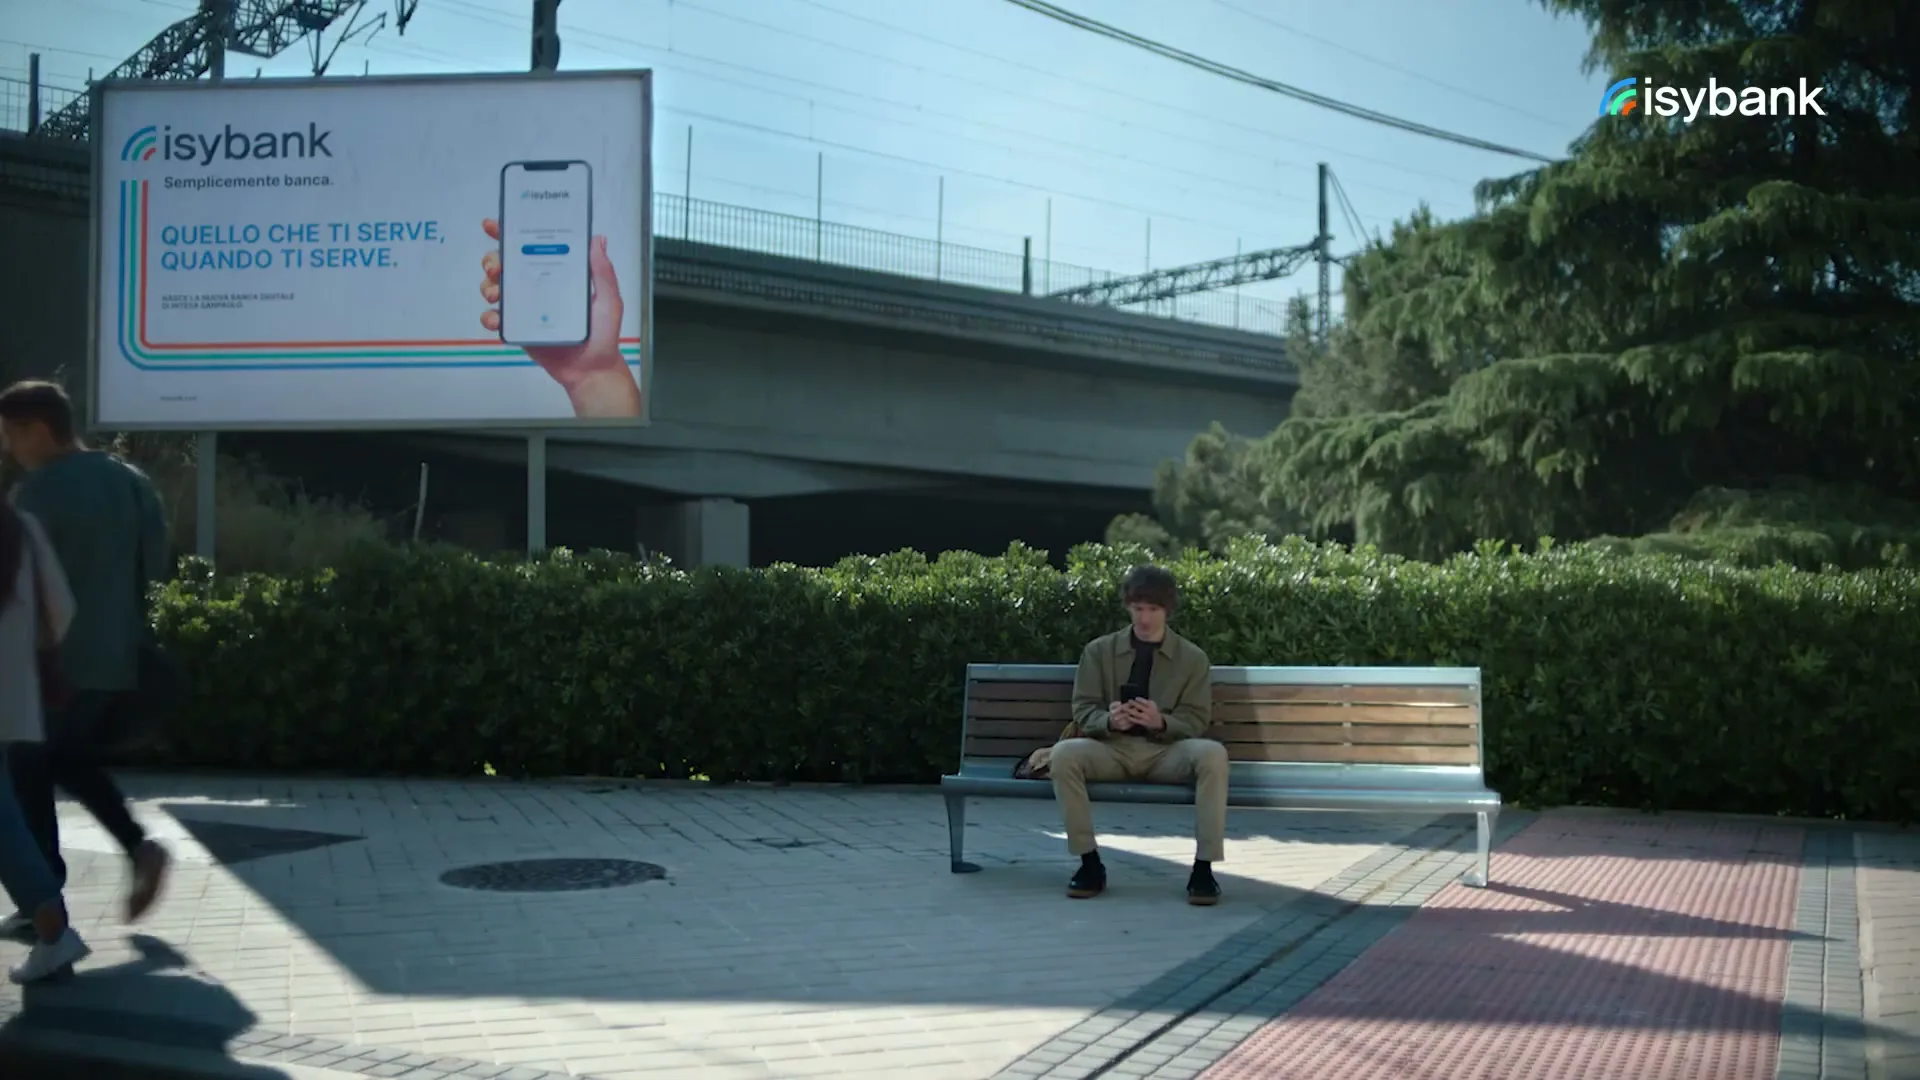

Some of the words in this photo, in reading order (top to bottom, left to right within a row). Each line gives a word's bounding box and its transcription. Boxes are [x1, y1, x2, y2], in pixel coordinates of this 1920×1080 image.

[164, 121, 333, 166] isybank
[164, 174, 280, 190] Semplicemente
[284, 174, 335, 187] banca.
[161, 224, 261, 245] QUELLO
[268, 223, 320, 244] CHE
[328, 223, 350, 243] TI
[357, 220, 446, 244] SERVE,
[161, 249, 273, 271] QUANDO
[280, 249, 302, 269] TI
[310, 247, 399, 268] SERVE.
